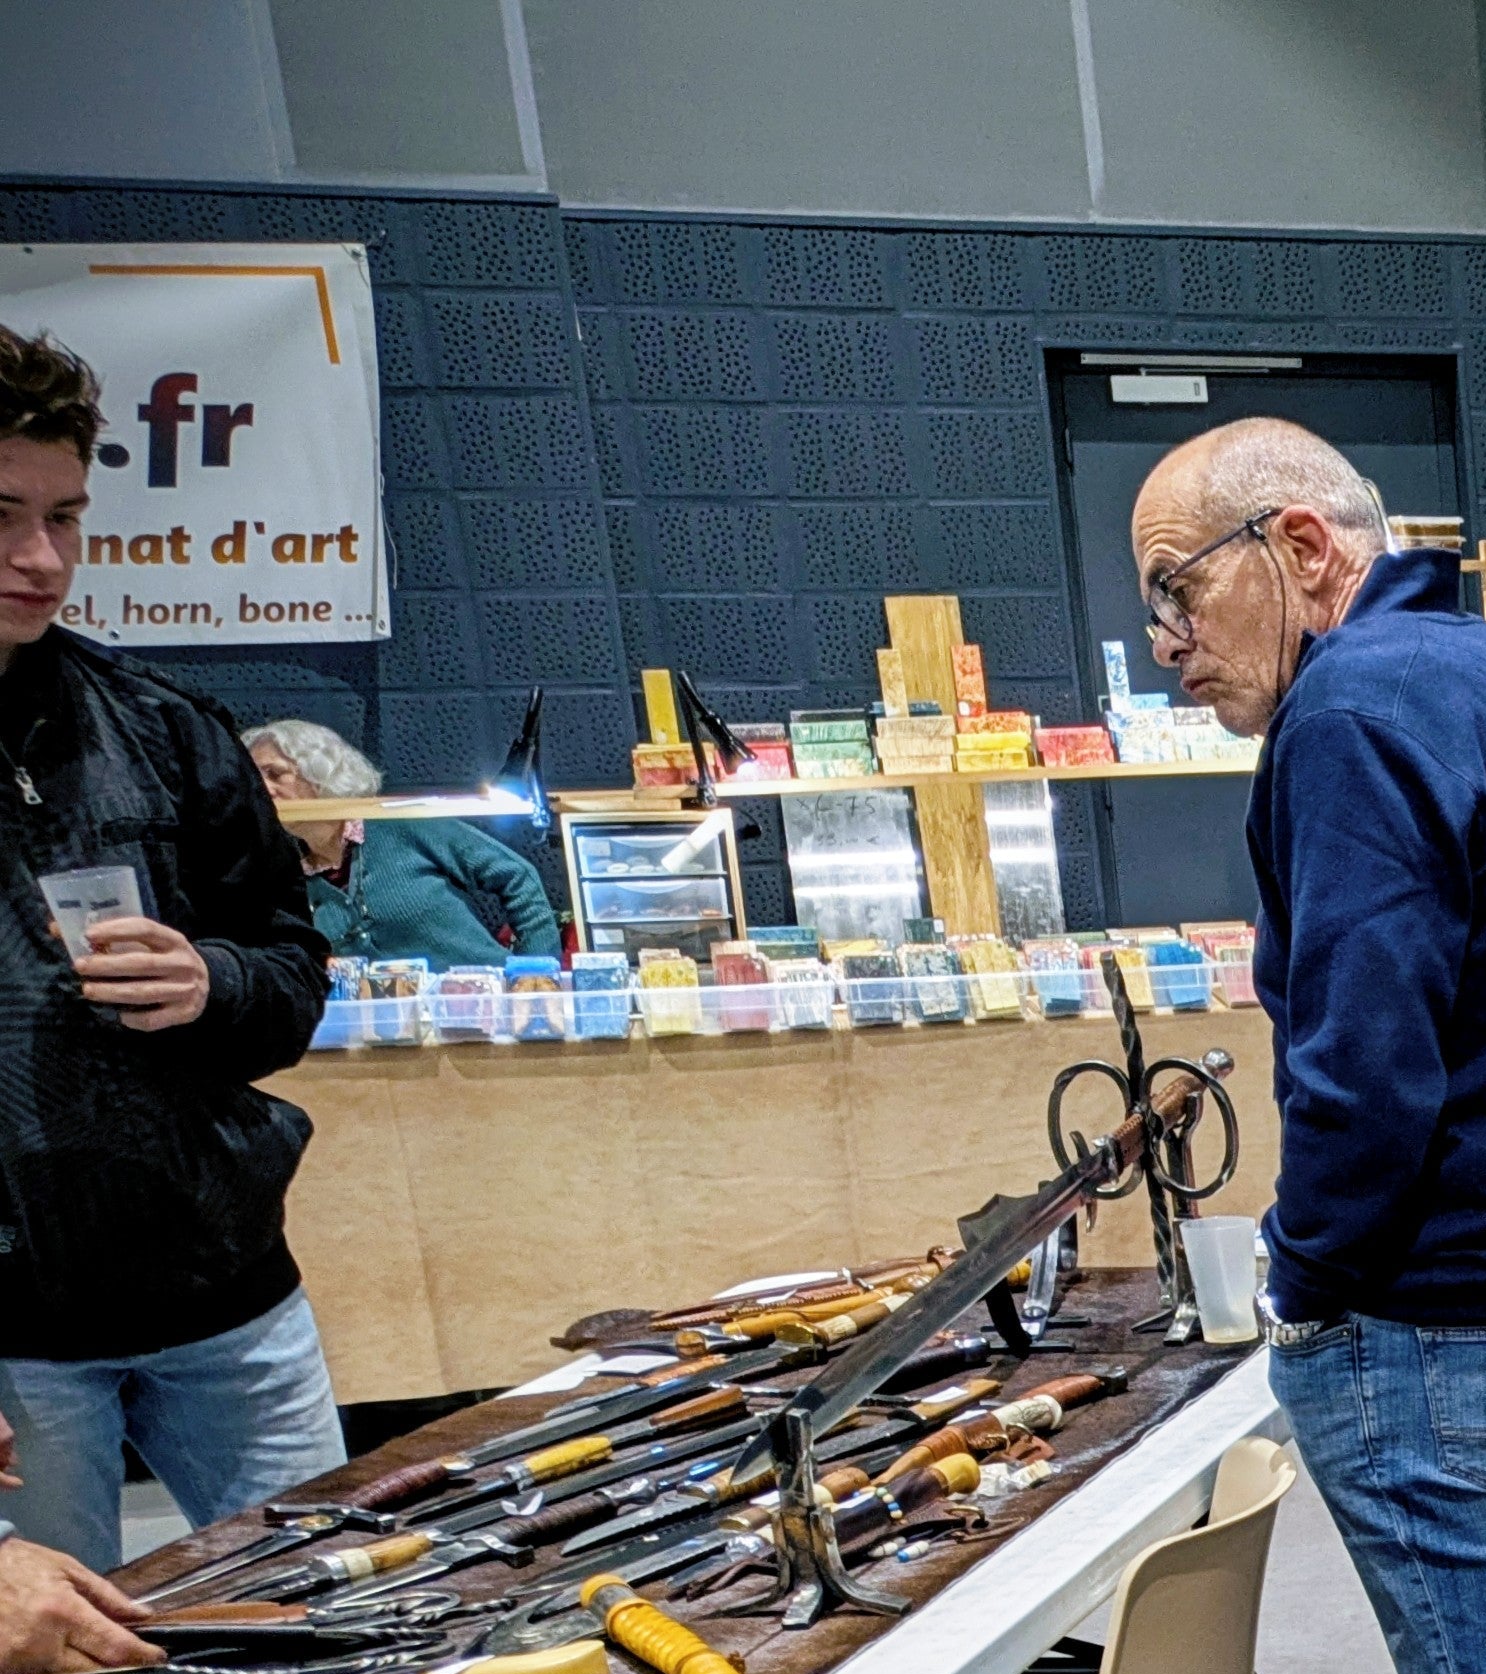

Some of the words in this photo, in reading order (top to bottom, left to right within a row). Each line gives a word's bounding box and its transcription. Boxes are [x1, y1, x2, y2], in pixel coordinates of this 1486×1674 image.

[211, 520, 359, 565] d'art
[122, 594, 223, 628] horn,
[239, 593, 333, 623] bone
